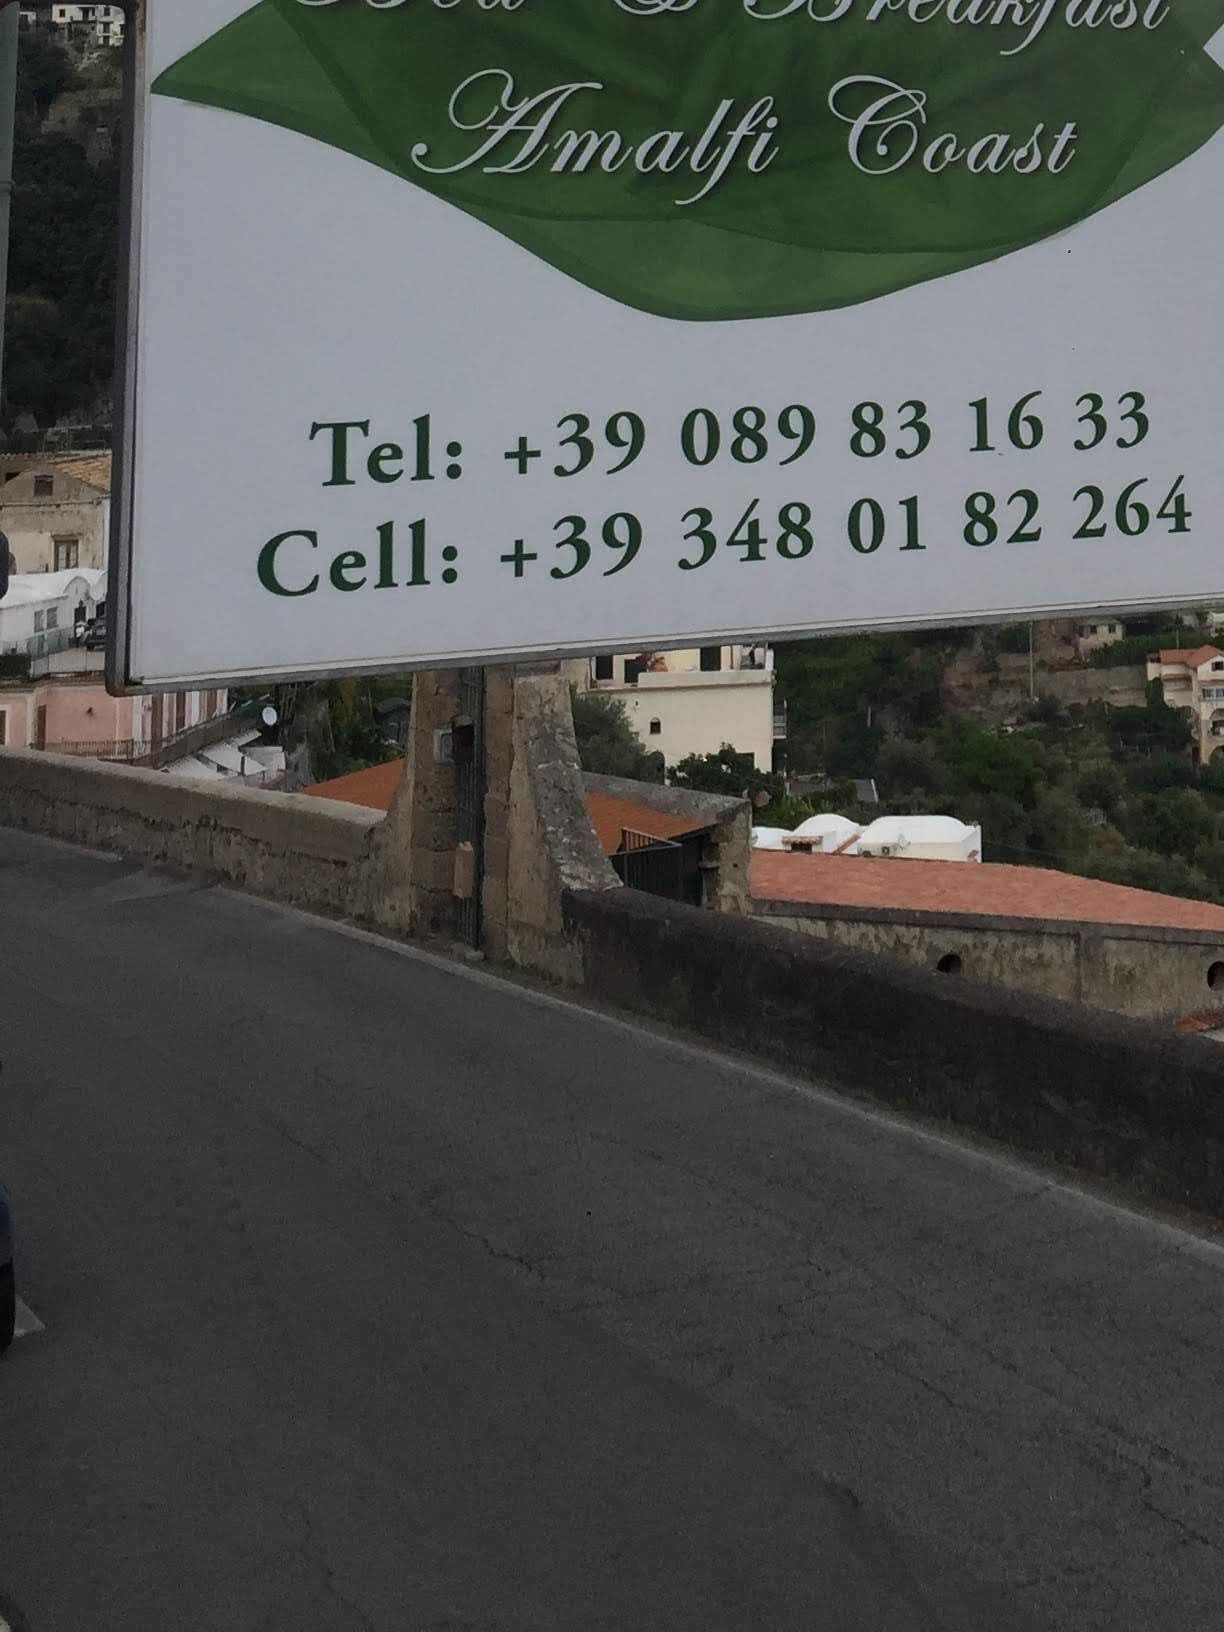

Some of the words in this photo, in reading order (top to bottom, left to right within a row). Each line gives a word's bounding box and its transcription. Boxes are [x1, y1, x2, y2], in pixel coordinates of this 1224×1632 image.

[410, 69, 778, 205] Amalfi
[829, 76, 1076, 174] Coast
[309, 413, 462, 487] Tel:
[504, 411, 645, 477] +39
[681, 404, 815, 466] 089
[850, 400, 931, 459] 83
[968, 390, 1043, 452] 16
[1074, 391, 1149, 451] 33
[256, 518, 458, 597] Cell:
[500, 512, 642, 579] +39
[678, 498, 814, 570] 348
[847, 495, 926, 554] 01
[963, 489, 1042, 547] 82
[1072, 475, 1192, 539] 264
